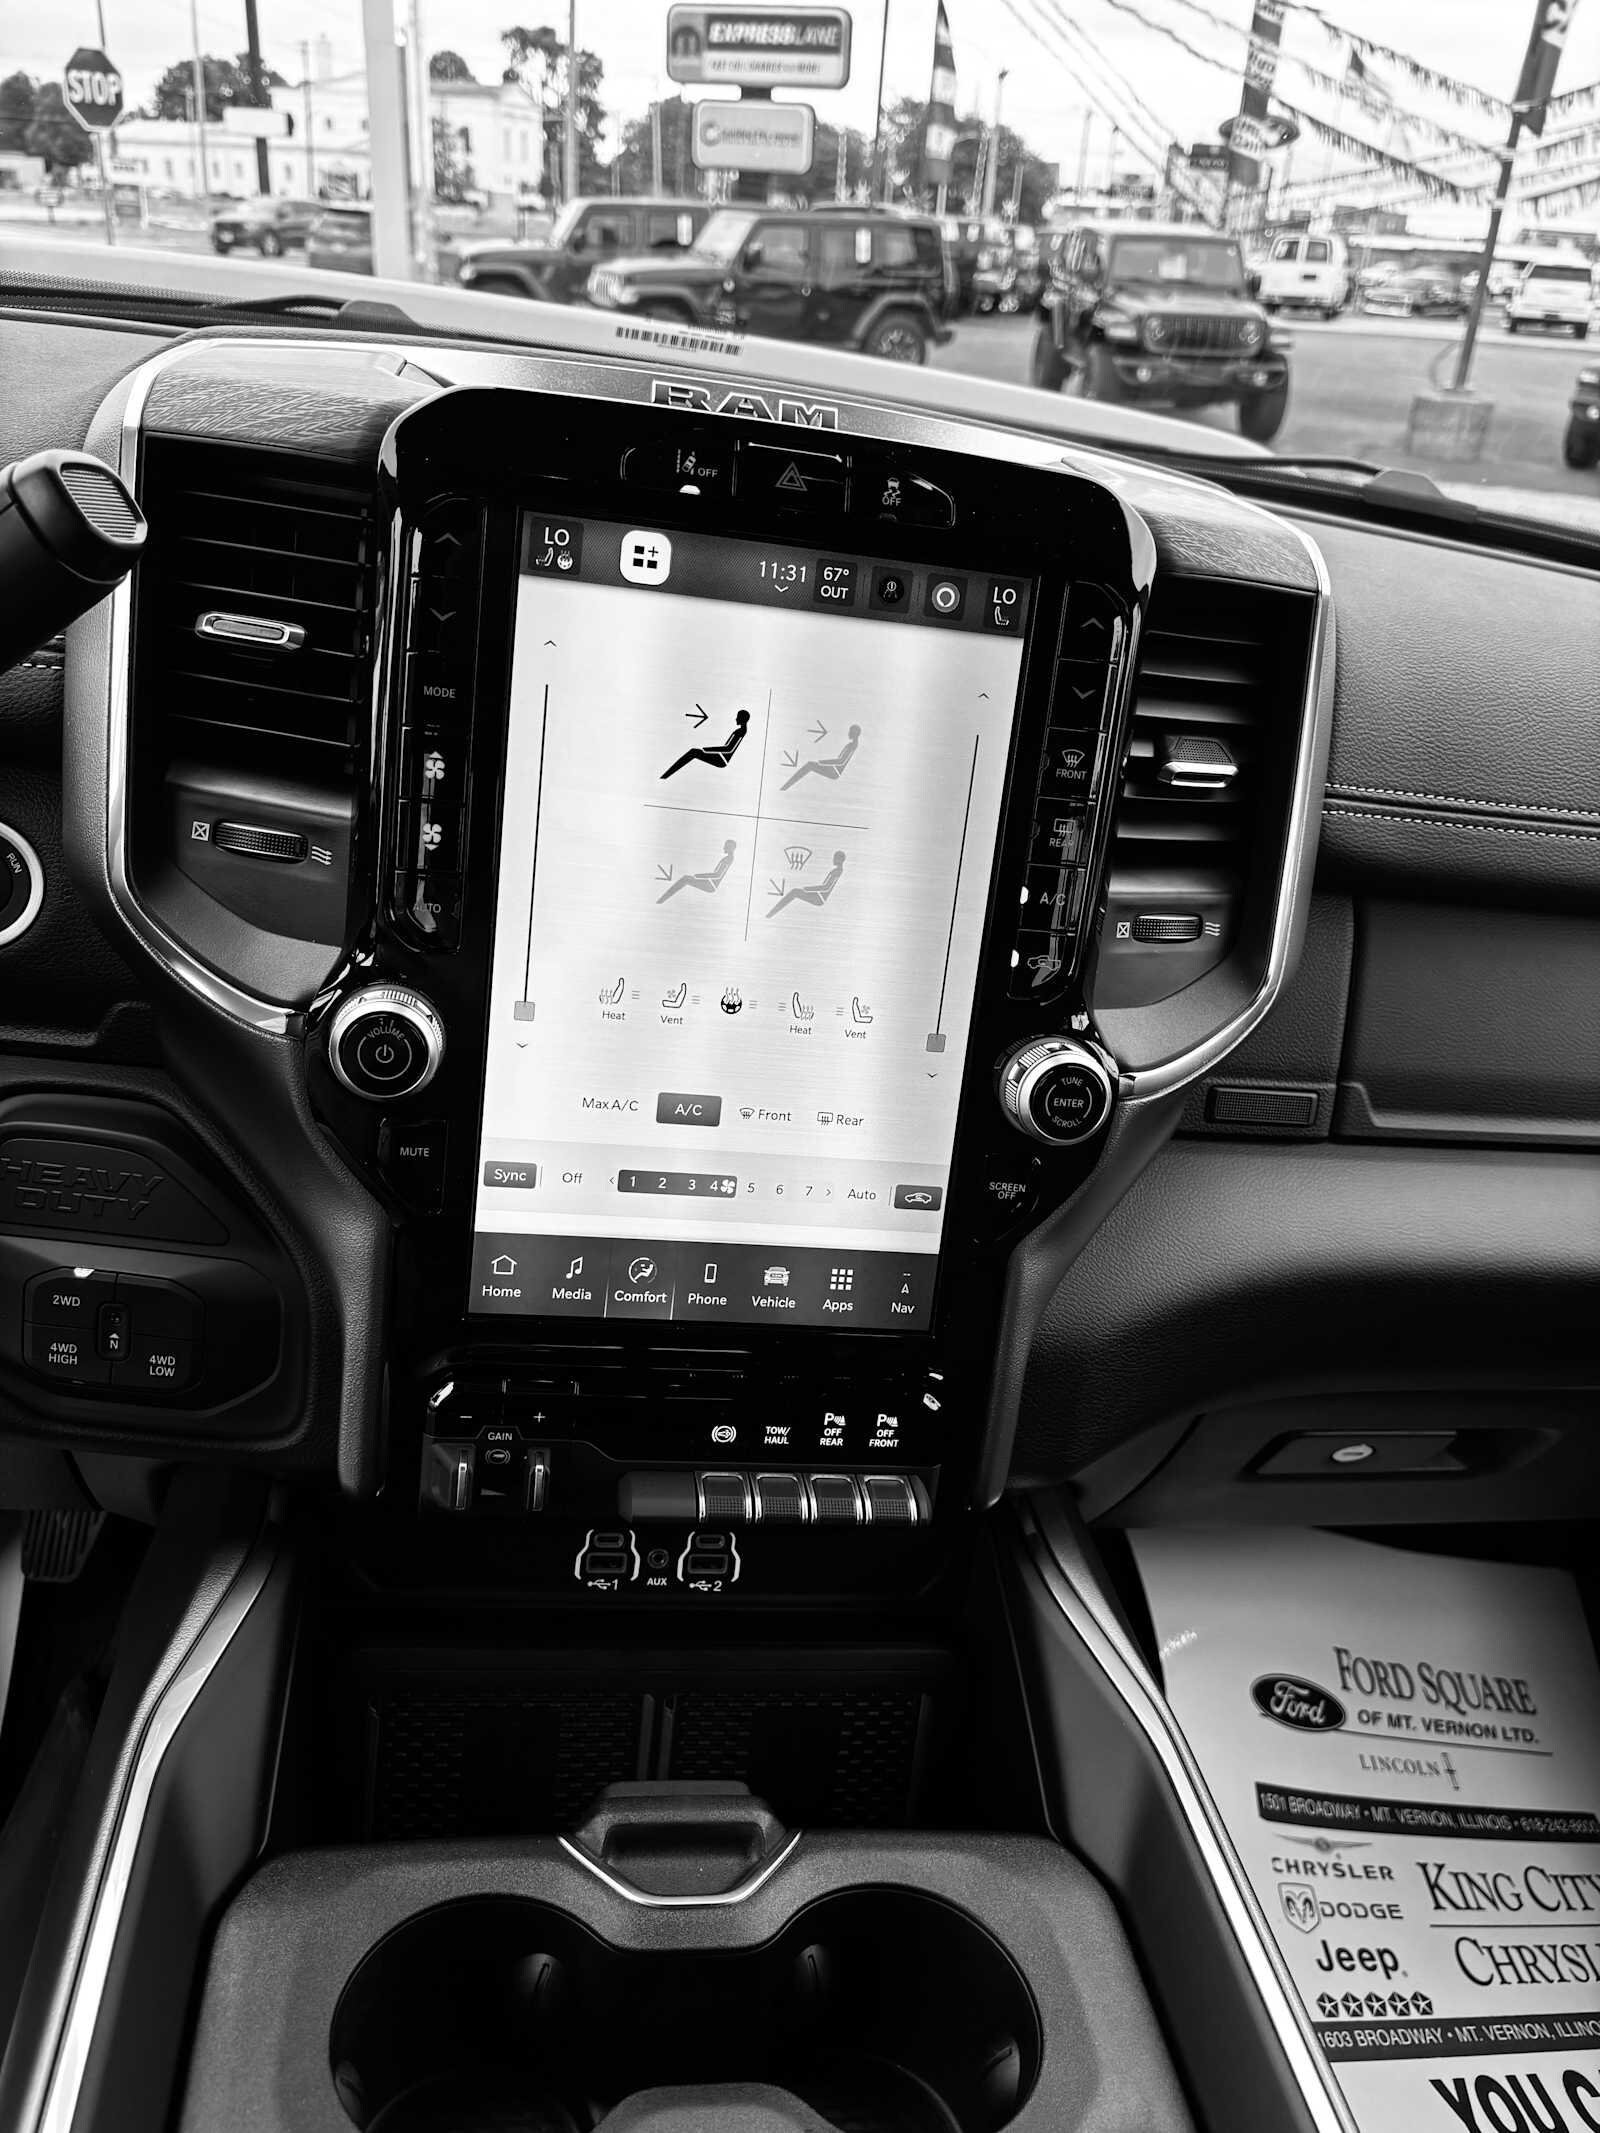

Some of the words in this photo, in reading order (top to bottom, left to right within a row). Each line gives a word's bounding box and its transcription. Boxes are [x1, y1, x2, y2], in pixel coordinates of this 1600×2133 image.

[68, 69, 121, 106] STOP
[652, 379, 838, 430] RAM
[697, 467, 719, 478] OFF
[881, 496, 902, 507] OFF
[544, 526, 570, 546] LO
[759, 561, 807, 583] 11:31
[823, 566, 850, 582] 67°
[820, 585, 849, 600] OUT
[993, 586, 1017, 605] LO
[423, 685, 457, 699] MODE
[1055, 768, 1088, 781] FRONT
[1048, 837, 1075, 849] REAR
[6, 852, 23, 875] RUN
[1039, 891, 1066, 906] A/C
[412, 902, 442, 914] AUTO
[601, 1010, 626, 1021] Heat
[660, 1015, 684, 1025] Vent
[366, 1025, 406, 1041] VOLUME
[789, 1024, 813, 1036] Heat
[844, 1029, 867, 1040] Vent
[1060, 1076, 1084, 1088] TUNE
[581, 1097, 609, 1111] Max
[611, 1099, 640, 1113] A/C
[674, 1104, 703, 1116] A/C
[1053, 1098, 1085, 1109] ENTER
[758, 1109, 793, 1122] Front
[836, 1114, 865, 1127] Rear
[1052, 1114, 1083, 1128] SCROLL
[399, 1146, 430, 1158] MUTE
[0, 1157, 167, 1196] HEAVY
[493, 1168, 527, 1184] Sync
[562, 1171, 584, 1185] Off
[629, 1176, 637, 1187] 1
[658, 1177, 667, 1189] 2
[687, 1179, 696, 1190] 3
[709, 1180, 719, 1191] 4
[747, 1182, 756, 1193] 5
[776, 1184, 784, 1195] 6
[805, 1186, 813, 1196] 7
[988, 1182, 1026, 1193] SCREEN
[847, 1188, 877, 1200] Auto
[997, 1191, 1017, 1200] OFF
[15, 1186, 150, 1220] DUTY
[482, 1285, 522, 1298] Home
[552, 1287, 592, 1300] Media
[614, 1290, 668, 1303] Comfort
[52, 1295, 81, 1307] 2WD
[687, 1293, 728, 1306] Phone
[751, 1295, 796, 1309] Vehicle
[822, 1299, 854, 1312] Apps
[891, 1302, 915, 1314] Nav
[50, 1342, 78, 1354] 4WD
[109, 1339, 119, 1350] N
[48, 1353, 78, 1366] HIGH
[149, 1355, 176, 1366] 4WD
[149, 1365, 176, 1377] LOW
[487, 1432, 513, 1441] GAIN
[765, 1425, 791, 1436] TOW/
[823, 1428, 843, 1437] OFF
[876, 1429, 895, 1438] OFF
[764, 1436, 789, 1445] HAUL
[819, 1437, 844, 1446] REAR
[869, 1439, 899, 1448] FRONT
[611, 1579, 618, 1591] 1
[646, 1577, 667, 1586] AUX
[713, 1580, 723, 1592] 2
[1333, 1646, 1415, 1700] FORD
[1417, 1662, 1537, 1717] SQUARE
[1269, 1681, 1326, 1725] Ford
[1357, 1709, 1382, 1726] OF
[1387, 1713, 1417, 1731] MT.
[1421, 1717, 1498, 1739] VERNON
[1501, 1726, 1540, 1744] LTD.
[1359, 1753, 1441, 1776] LINCOLN
[1287, 1795, 1361, 1820] BROADWAY
[1371, 1806, 1396, 1823] MT.
[1457, 1811, 1513, 1832] ILLINOIS
[1271, 1856, 1395, 1881] CHRYSLER
[1416, 1862, 1523, 1912] KING
[1319, 1901, 1405, 1920] DODGE
[1315, 1939, 1400, 1981] Jeep
[1317, 2030, 1354, 2048] 1603
[1354, 2027, 1444, 2047] BROADWAY
[1454, 2025, 1484, 2042] MT.
[1481, 2022, 1556, 2041] VERNON,
[1428, 2073, 1570, 2133] YOU
